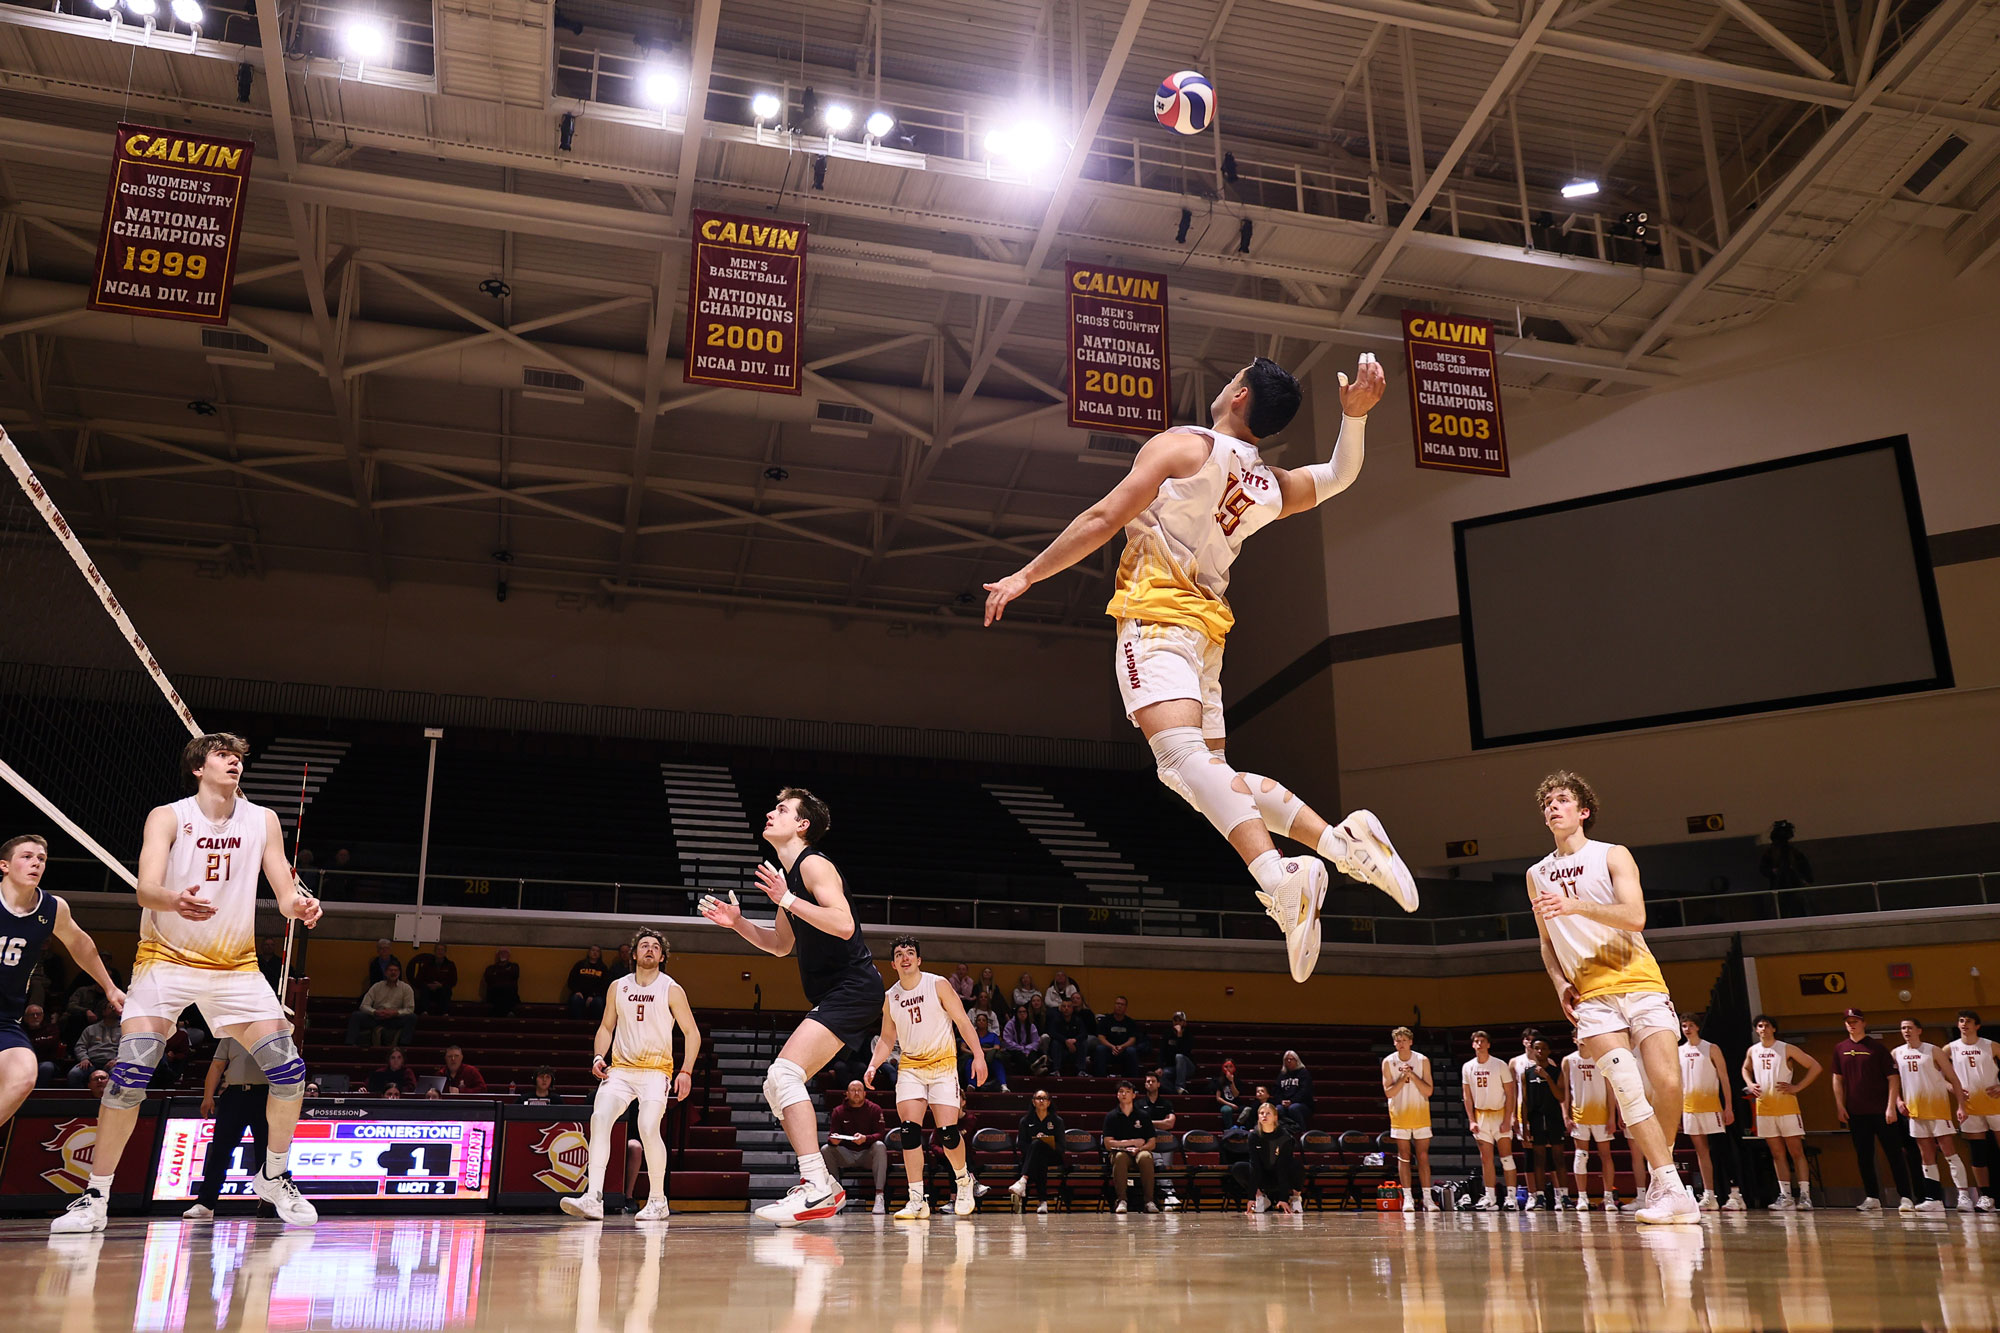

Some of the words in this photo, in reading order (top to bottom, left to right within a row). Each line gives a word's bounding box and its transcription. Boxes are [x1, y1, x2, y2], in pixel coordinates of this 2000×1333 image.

[125, 134, 242, 169] CALVIN
[147, 174, 211, 192] WOMEN'S
[120, 182, 165, 198] CROSS
[170, 190, 233, 208] COUNTRY
[125, 207, 219, 231] NATIONAL
[113, 221, 226, 248] CHAMPIONS
[701, 219, 799, 250] CALVIN
[124, 246, 207, 279] 1999
[730, 257, 768, 271] MEN'S
[709, 266, 787, 284] BASKETBALL
[1073, 270, 1159, 300] CALVIN
[105, 280, 151, 298] NCAA
[157, 287, 189, 302] DIV.
[196, 292, 216, 305] III
[708, 287, 786, 308] NATIONAL
[700, 301, 793, 323] CHAMPIONS
[1101, 307, 1133, 320] MEN'S
[1076, 314, 1109, 328] CROSS
[1113, 320, 1160, 333] COUNTRY
[1409, 318, 1486, 345] CALVIN
[707, 323, 783, 353] 2000
[1083, 335, 1154, 355] NATIONAL
[697, 356, 736, 371] NCAA
[741, 361, 768, 375] DIV.
[774, 365, 790, 377] III
[1077, 348, 1161, 370] CHAMPIONS
[1415, 360, 1445, 372] CROSS
[1448, 364, 1490, 377] COUNTRY
[1437, 353, 1466, 364] MEN'S
[1085, 370, 1154, 398] 2000
[1423, 380, 1487, 397] NATIONAL
[1079, 400, 1113, 415] NCAA
[1118, 406, 1142, 419] DIV.
[1147, 409, 1162, 421] III
[1419, 392, 1494, 412] CHAMPIONS
[1428, 413, 1490, 440] 2003
[1424, 442, 1456, 455] NCAA
[1459, 446, 1481, 459] DIV.
[1485, 450, 1499, 461] III
[1124, 642, 1140, 690] KNIGHTS
[196, 837, 241, 849] CALVIN
[206, 854, 230, 882] 21
[1550, 866, 1584, 882] CALVIN
[464, 880, 489, 894] 218
[1088, 908, 1110, 920] 219
[628, 994, 654, 1002] CALVIN
[900, 994, 924, 1008] CALVIN
[636, 1004, 644, 1022] 9
[908, 1006, 922, 1024] 13
[1690, 1059, 1694, 1069] 7
[1762, 1059, 1771, 1070] 15
[1582, 1070, 1592, 1081] 14
[354, 1126, 460, 1139] CORNERSTONE
[168, 1132, 188, 1186] CALVIN
[226, 1146, 248, 1176] 1
[297, 1153, 342, 1166] SET
[349, 1150, 362, 1168] 5
[406, 1147, 430, 1176] 1
[464, 1130, 484, 1190] KNIGHTS
[435, 1182, 446, 1194] 2
